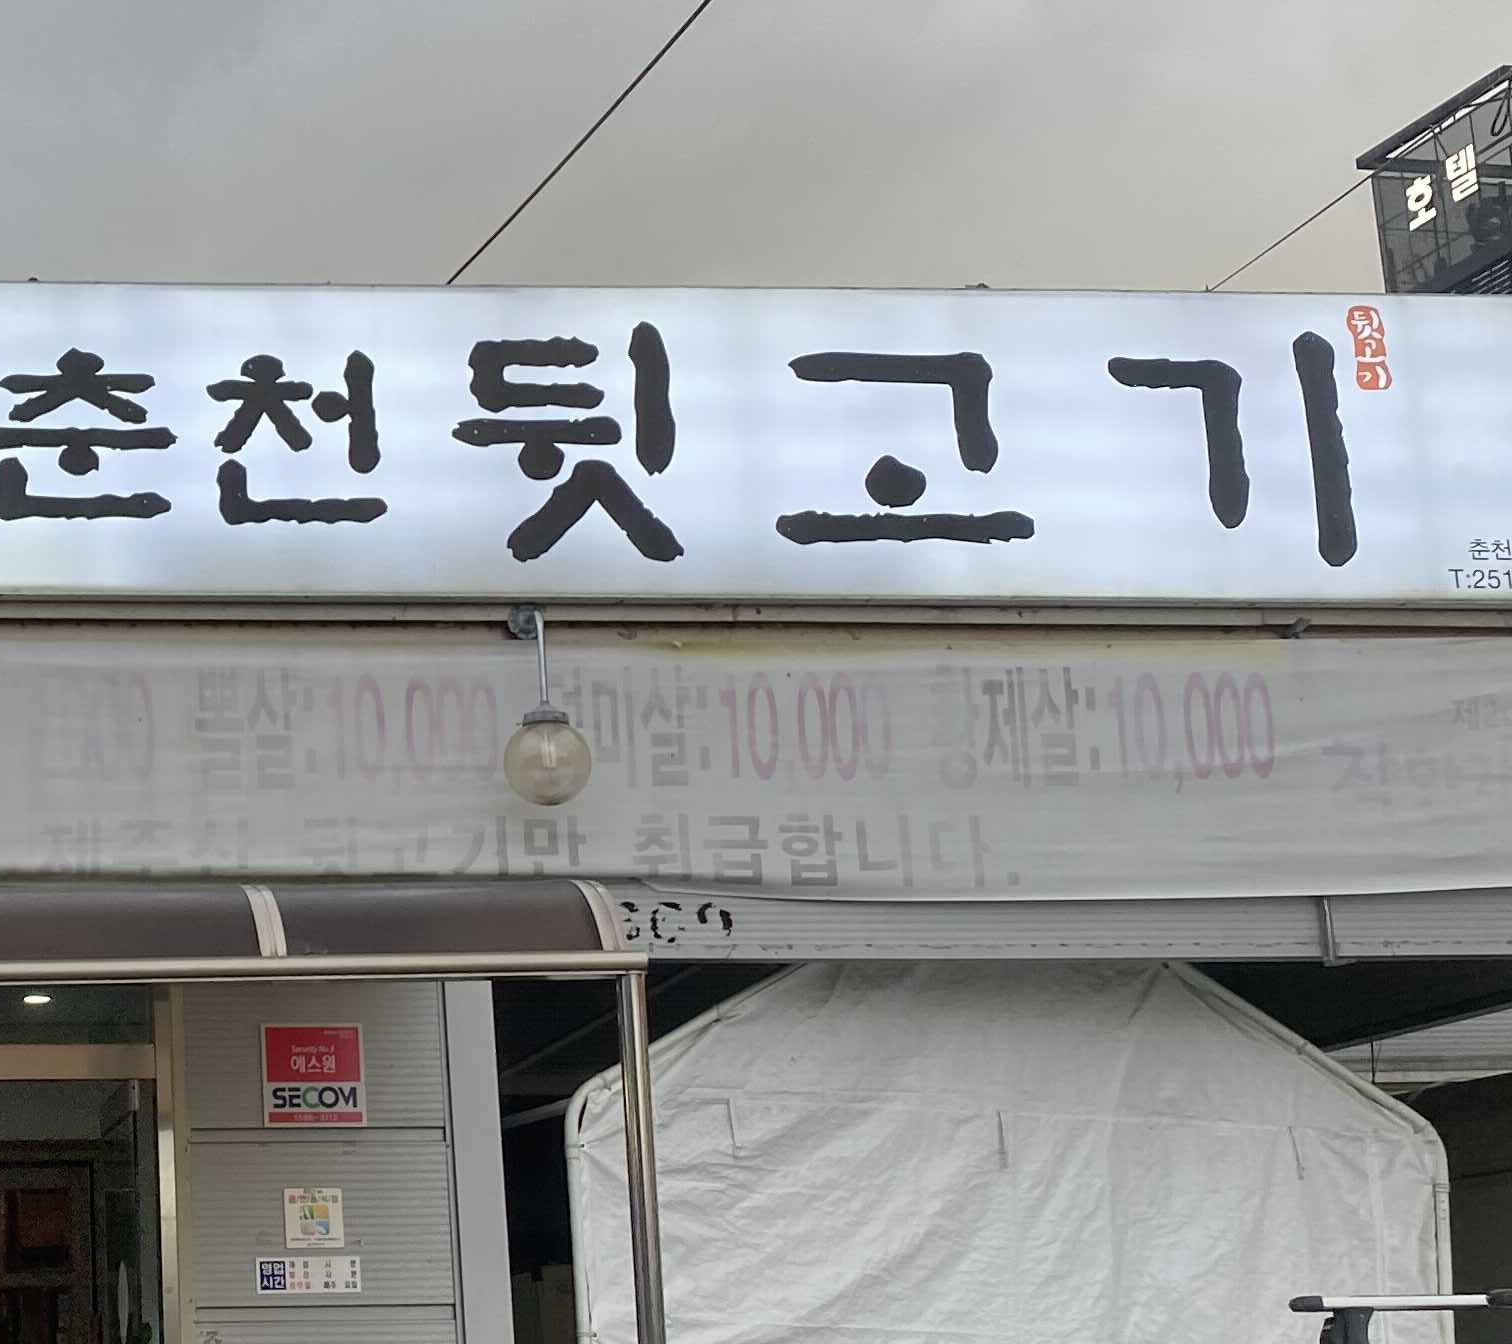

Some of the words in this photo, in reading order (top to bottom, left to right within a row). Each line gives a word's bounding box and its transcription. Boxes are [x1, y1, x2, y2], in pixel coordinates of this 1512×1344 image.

[1405, 144, 1480, 232] 호텔
[1350, 310, 1387, 389] 뒷고기
[452, 321, 1358, 568] 뒷고기
[1468, 538, 1512, 561] 춘천
[290, 1054, 336, 1073] 에스원
[272, 1086, 358, 1109] SECOM
[261, 1263, 284, 1275] 영업
[262, 1276, 285, 1289] 시간
